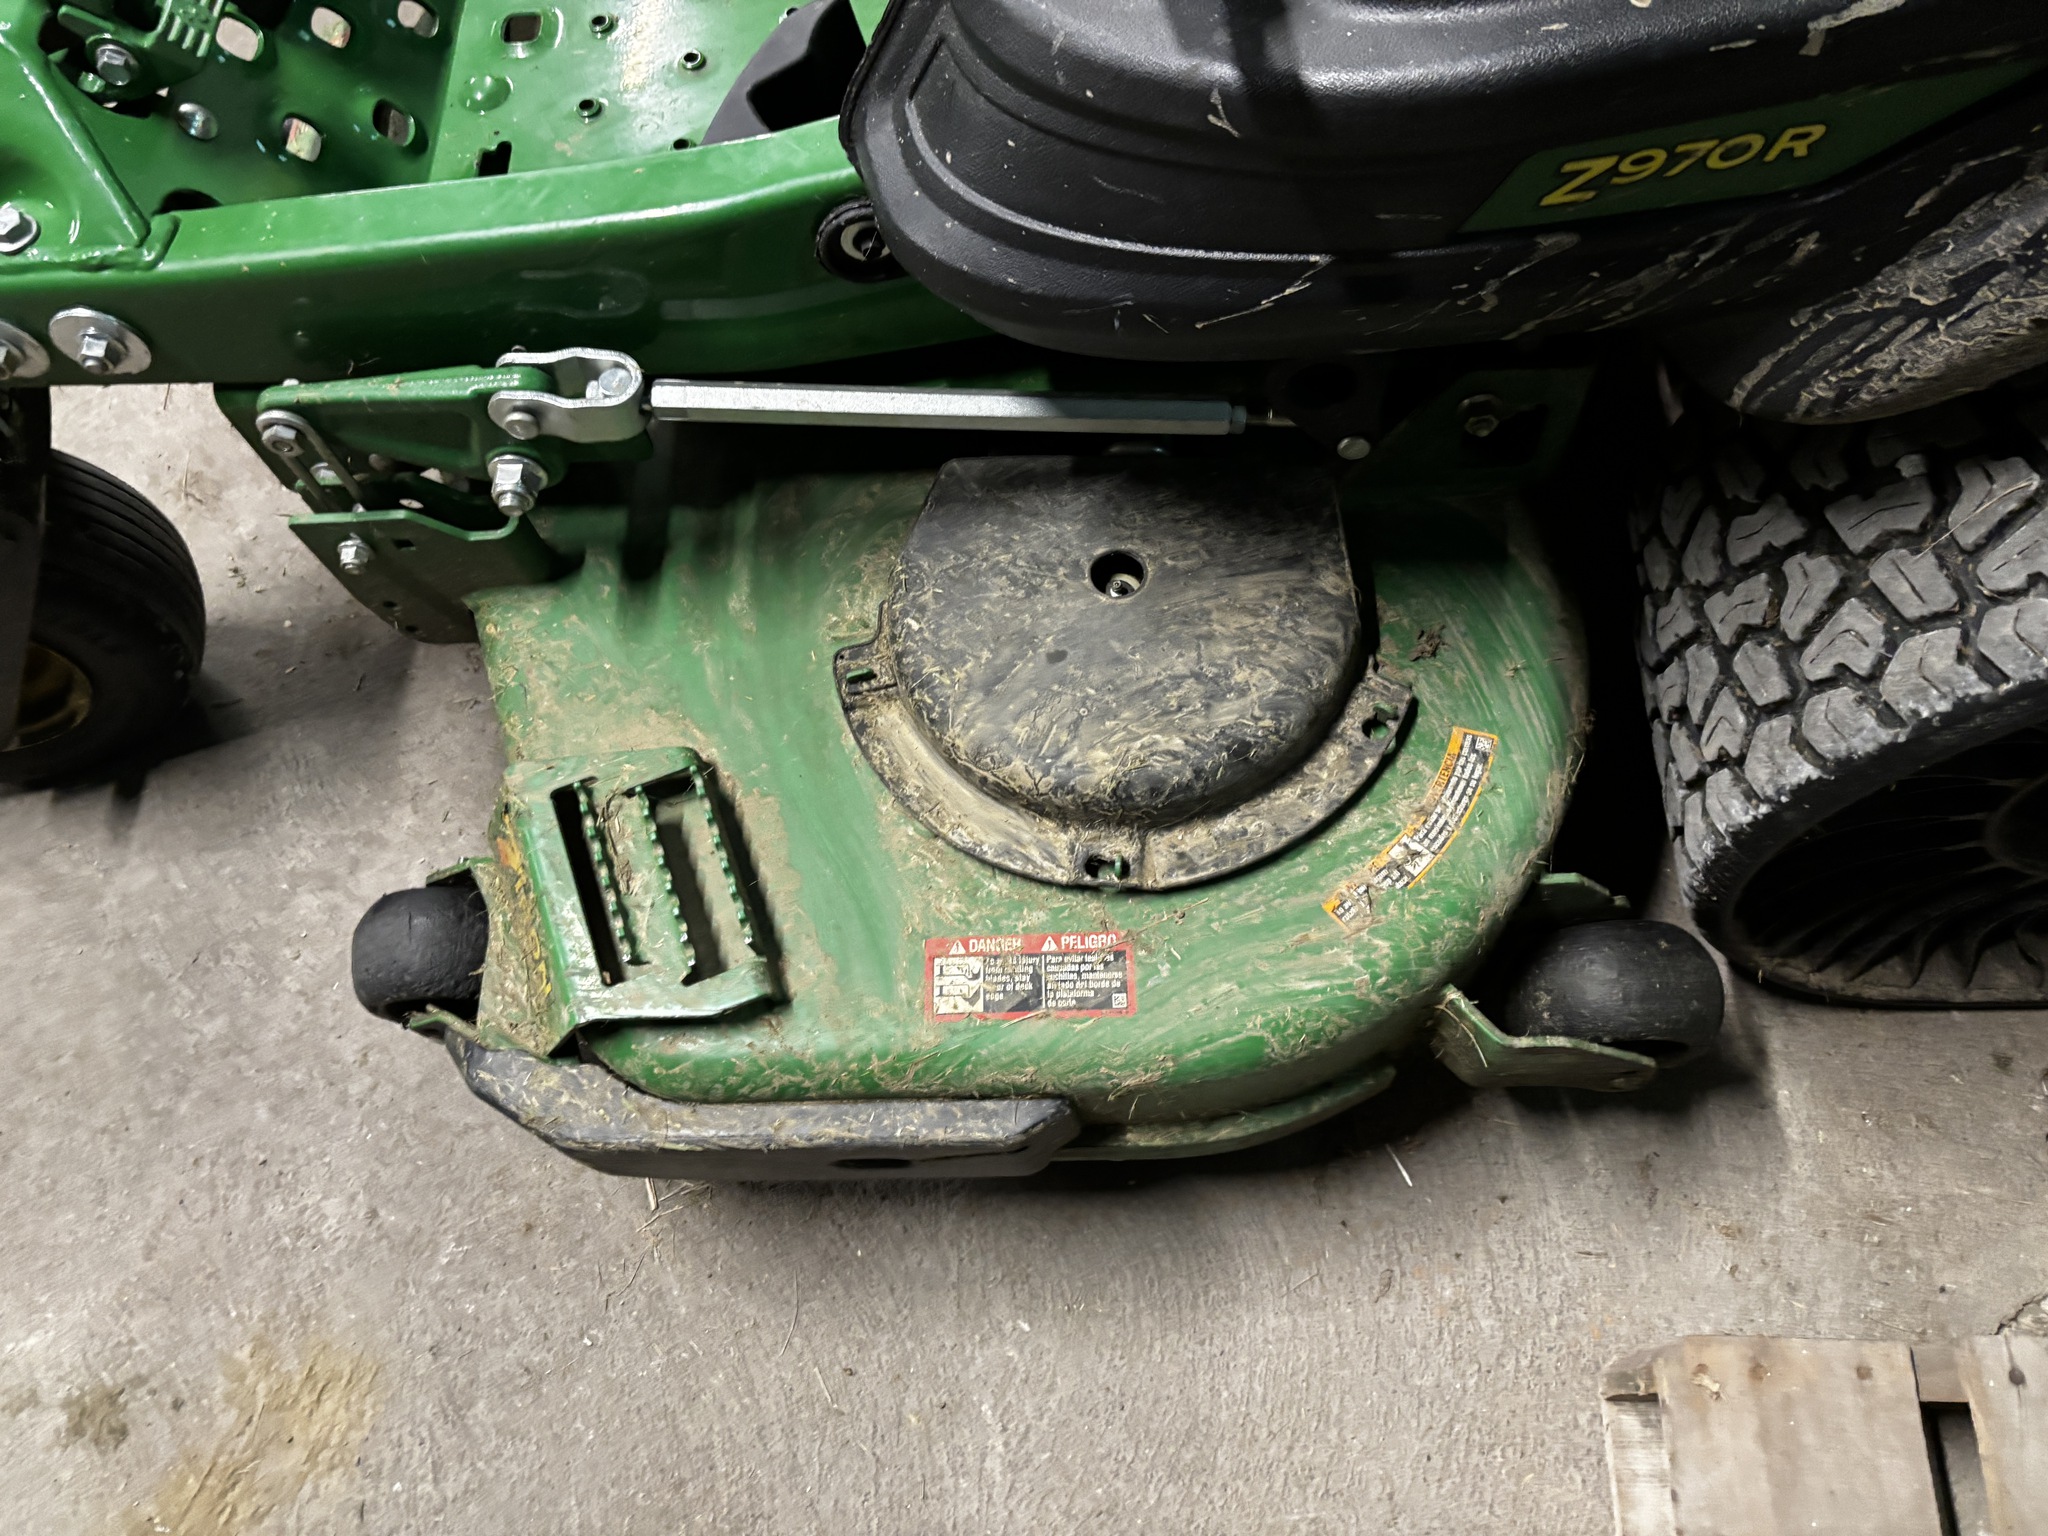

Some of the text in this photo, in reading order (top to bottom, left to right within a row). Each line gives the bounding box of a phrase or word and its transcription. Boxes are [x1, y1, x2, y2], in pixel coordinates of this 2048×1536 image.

[1538, 123, 1827, 208] Z970R
[969, 937, 1021, 952] DANGER
[1061, 934, 1116, 949] PELIGRO
[1019, 955, 1040, 965] injury
[1046, 954, 1062, 963] Para
[1085, 953, 1114, 962] lesies
[1080, 964, 1092, 973] por
[1111, 980, 1121, 988] de
[1056, 989, 1094, 999] plataforma
[1047, 999, 1056, 1007] de
